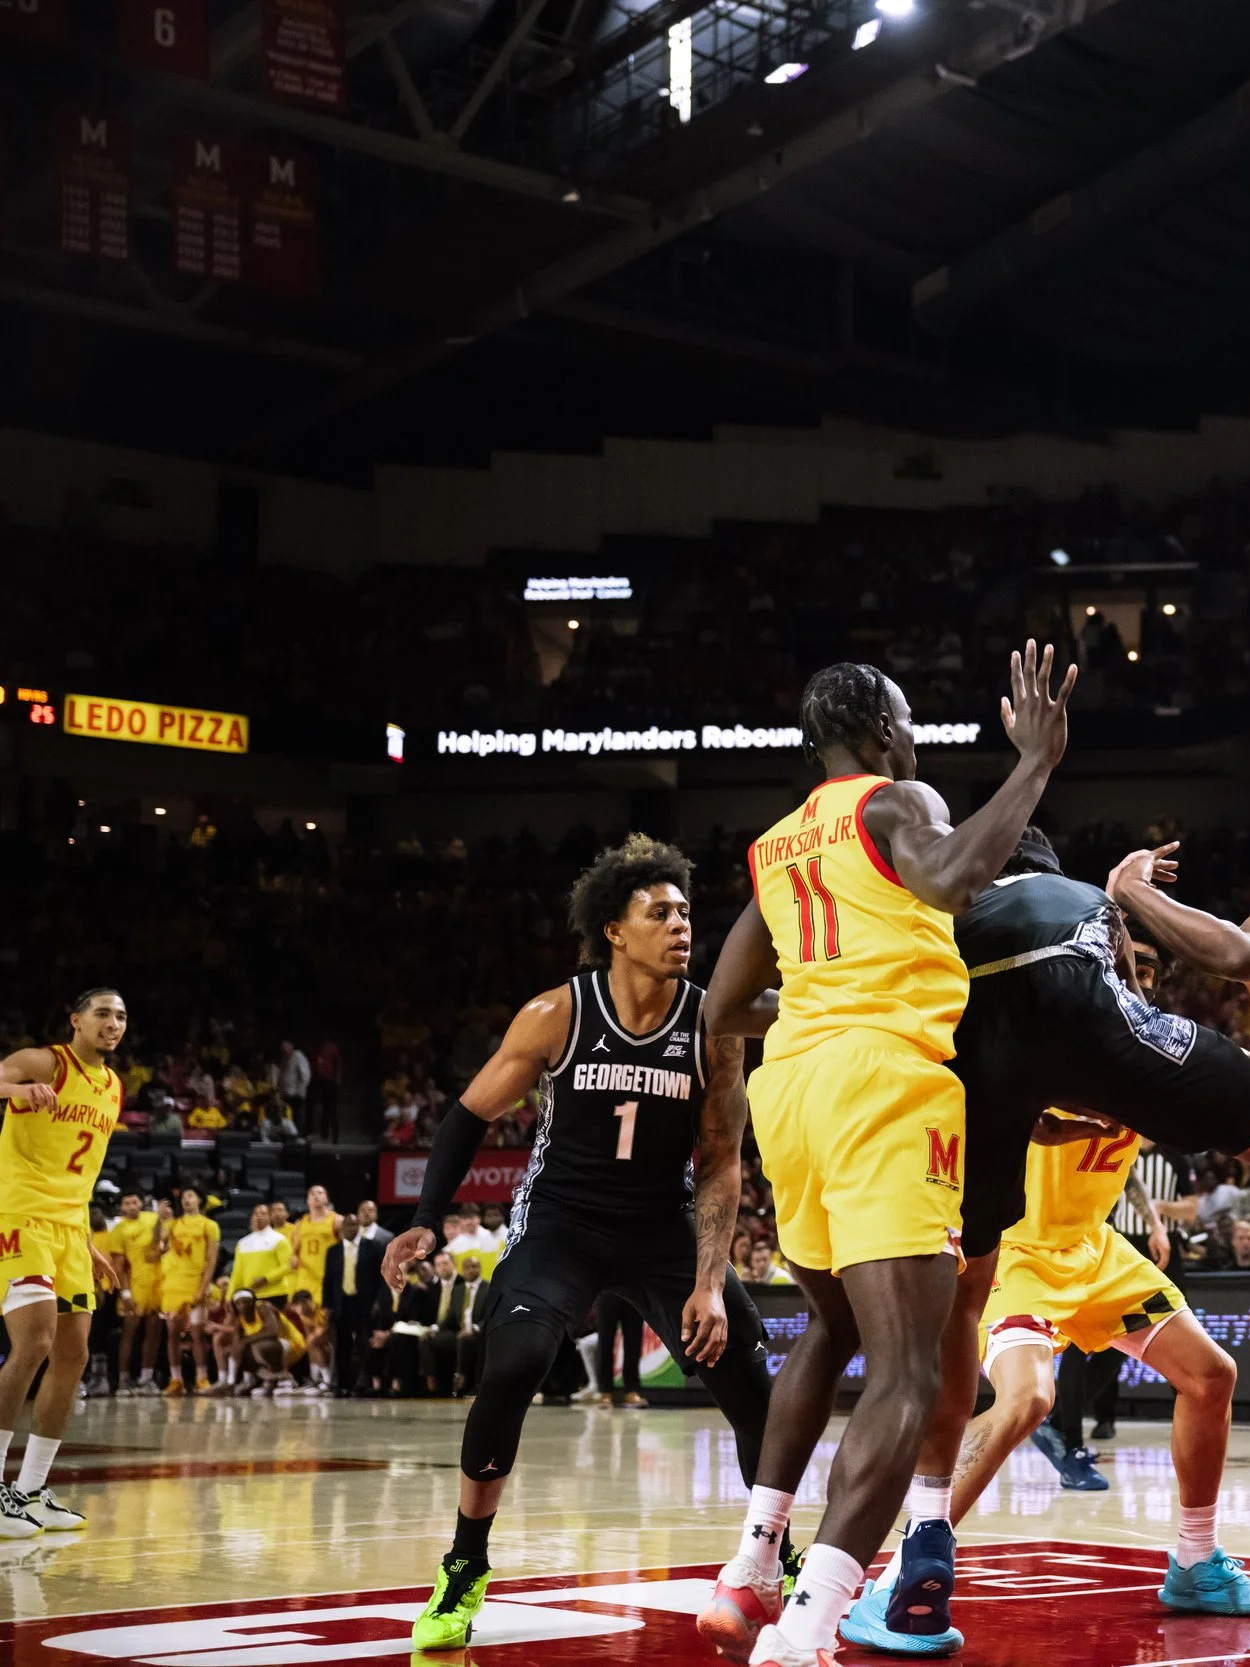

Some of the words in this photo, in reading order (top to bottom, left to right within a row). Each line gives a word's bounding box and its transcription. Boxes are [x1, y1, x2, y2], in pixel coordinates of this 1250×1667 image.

[153, 8, 177, 48] 6
[81, 116, 108, 149] M
[195, 140, 222, 172] M
[269, 155, 296, 187] M
[68, 700, 147, 736] LEDO
[159, 711, 246, 748] PIZZA
[437, 728, 537, 757] Helping
[541, 724, 697, 755] Marylanders
[701, 724, 804, 749] Reboun
[911, 722, 981, 745] ancer
[801, 796, 821, 824] M
[757, 823, 826, 870] TURKSON
[828, 814, 857, 845] JR.
[786, 855, 842, 963] 11
[573, 1063, 692, 1101] GEORGETOWN
[52, 1103, 113, 1137] MARYLAN
[613, 1101, 639, 1160] 1
[66, 1130, 93, 1175] 2
[926, 1127, 961, 1185] M
[1075, 1127, 1138, 1173] 12
